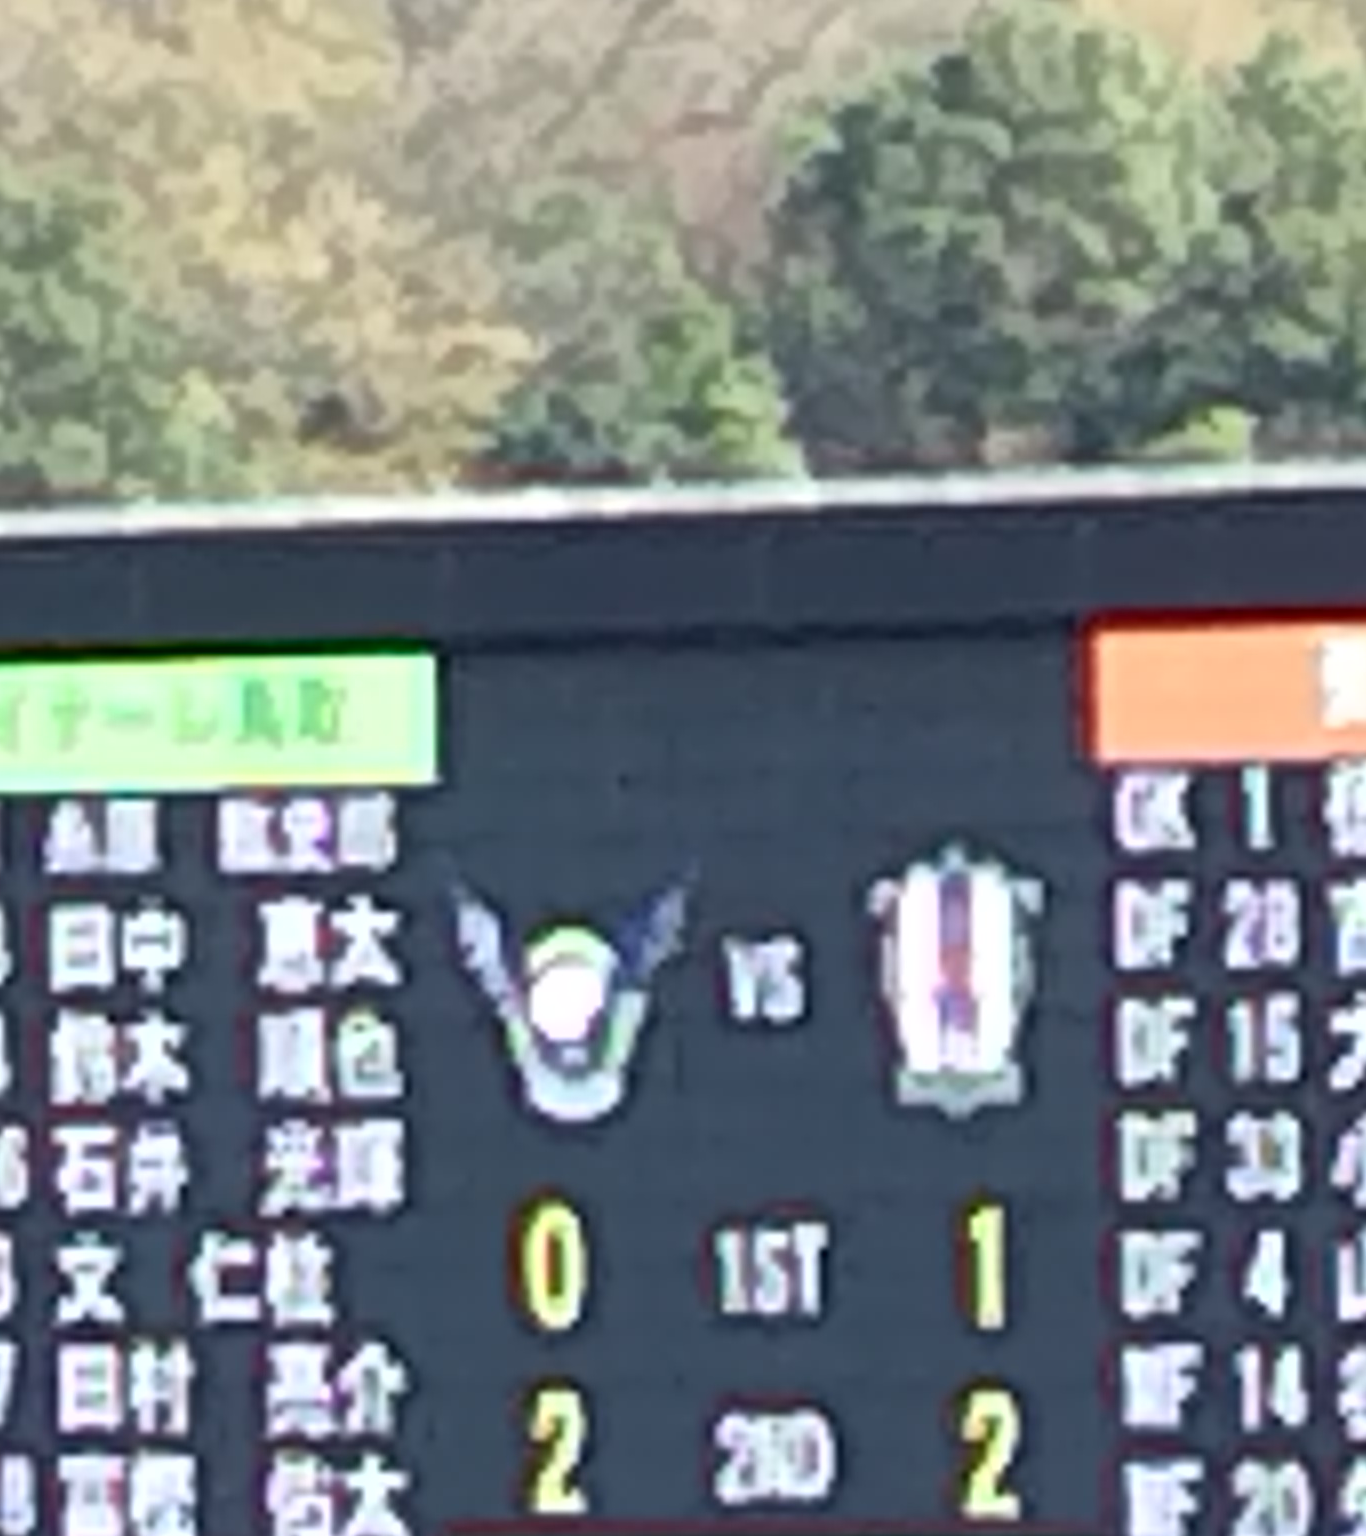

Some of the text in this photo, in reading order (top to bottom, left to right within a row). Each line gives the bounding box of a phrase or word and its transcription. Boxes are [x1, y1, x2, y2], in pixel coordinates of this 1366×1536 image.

[1243, 764, 1271, 849] 1
[724, 936, 805, 1022] VS
[1230, 993, 1301, 1082] 15
[51, 1124, 189, 1215] 石井
[522, 1202, 1007, 1330] 0 1ST 1
[1243, 1230, 1287, 1316] 4
[57, 1342, 195, 1435] 田村
[1237, 1347, 1308, 1430] 14
[529, 1389, 588, 1515] 2
[962, 1390, 1020, 1519] 2
